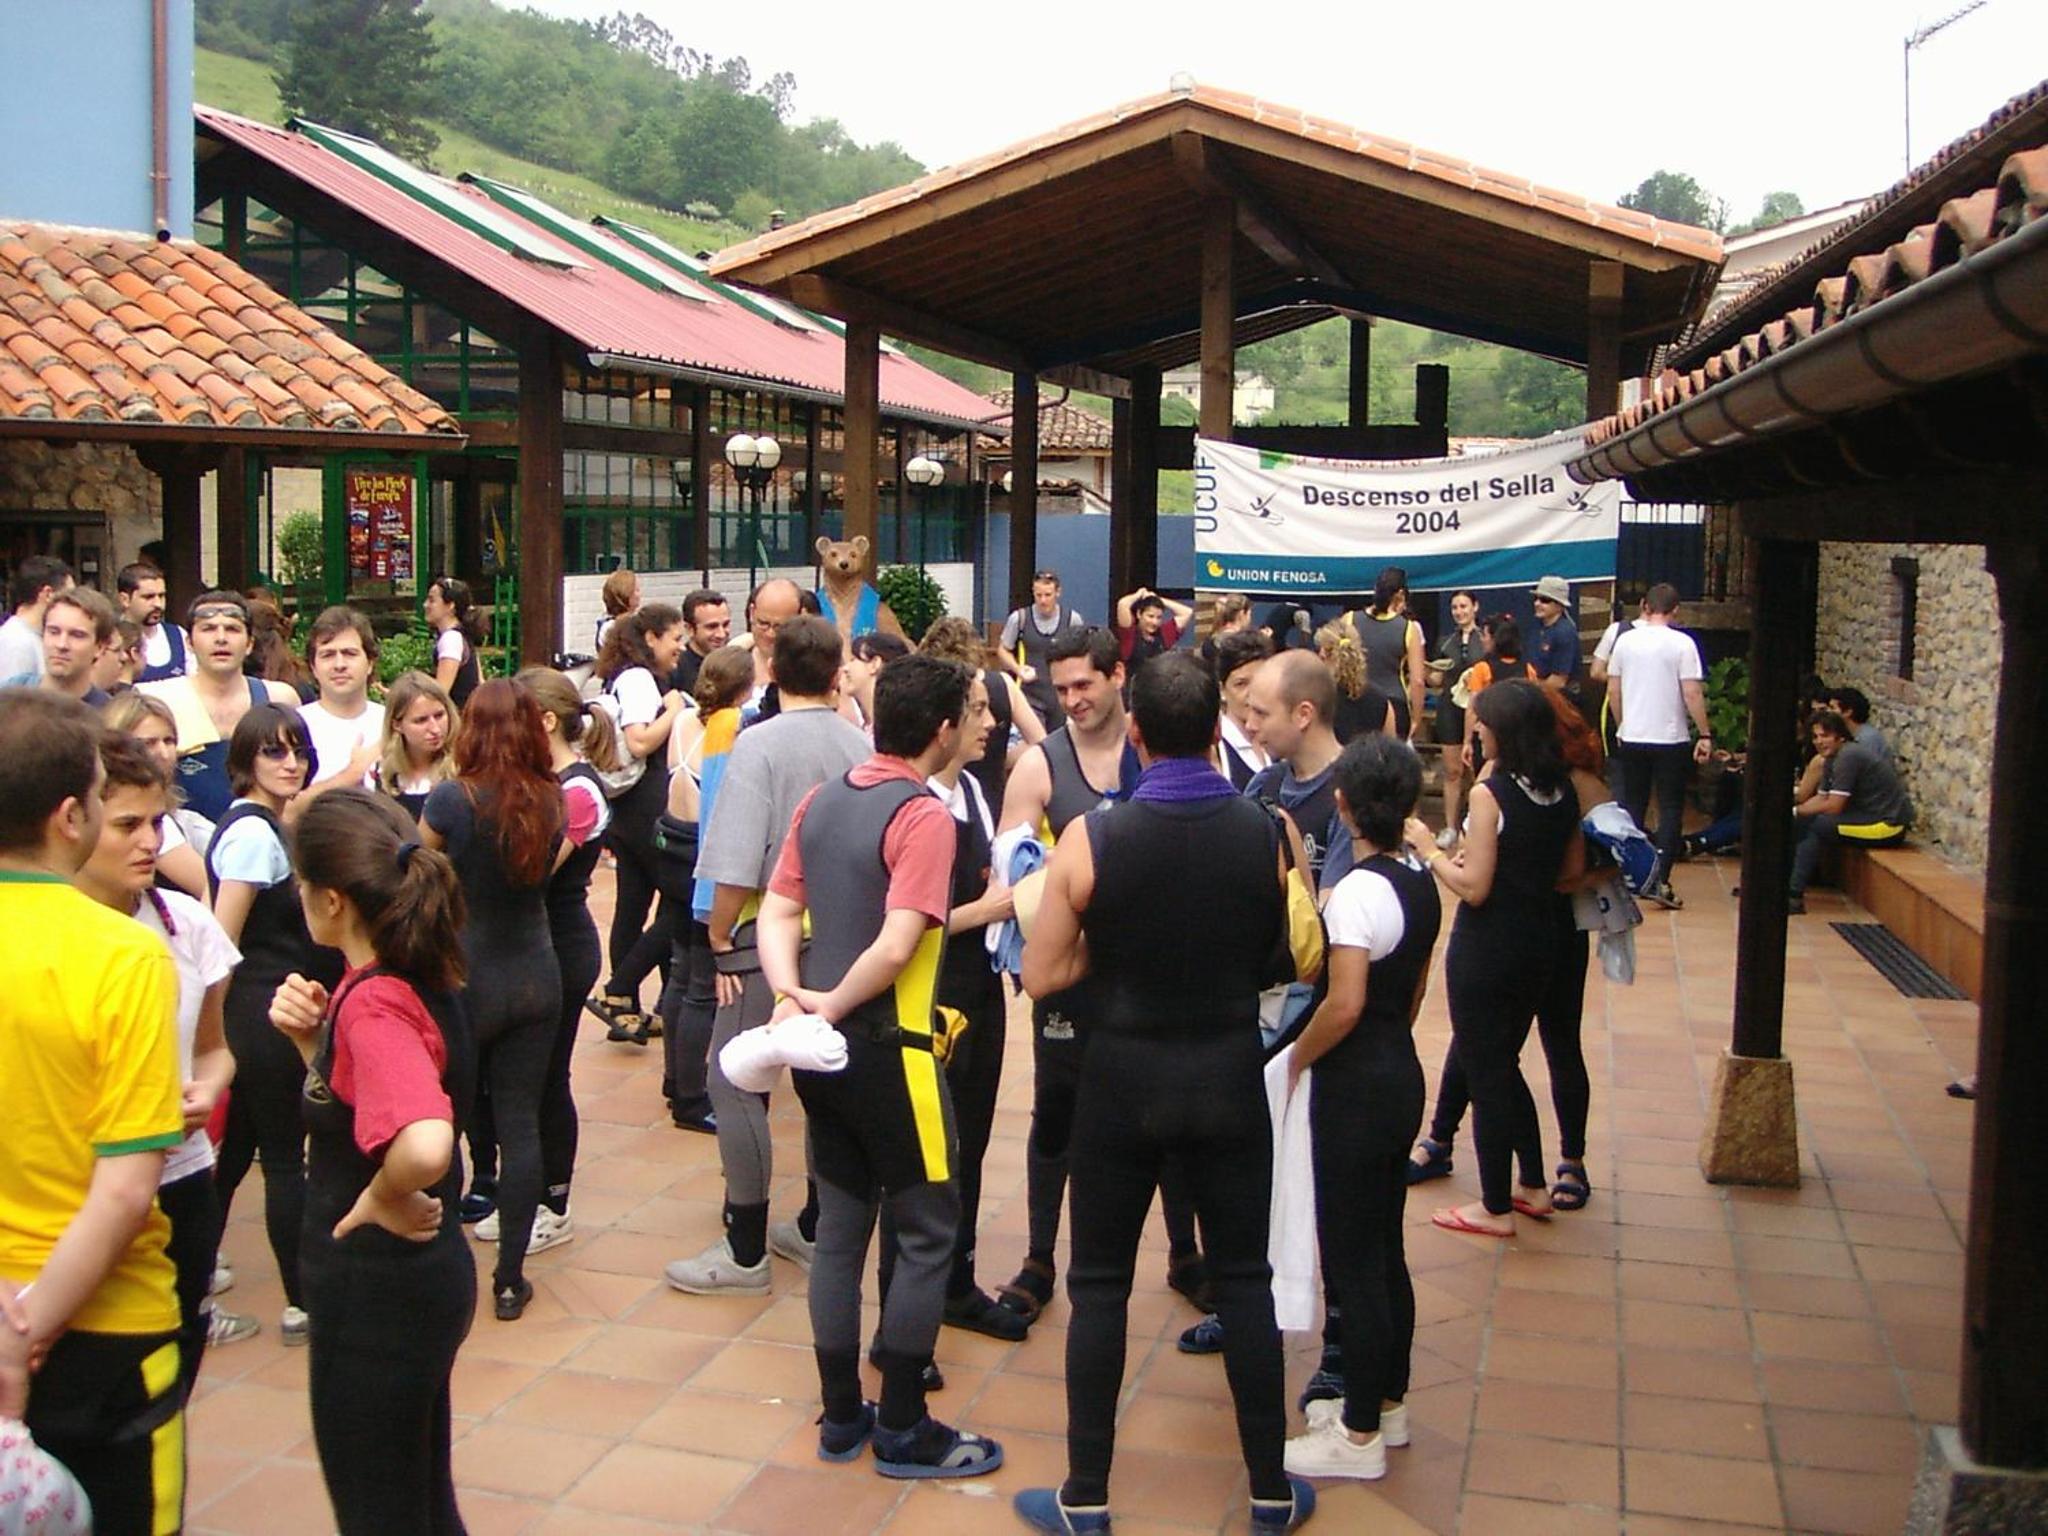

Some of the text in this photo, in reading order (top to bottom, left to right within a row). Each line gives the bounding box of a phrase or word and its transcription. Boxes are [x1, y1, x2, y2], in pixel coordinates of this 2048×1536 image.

[1303, 474, 1555, 507] Descenso del Sella
[1395, 510, 1461, 534] 2004
[1227, 569, 1327, 584] UNION FENOSA
